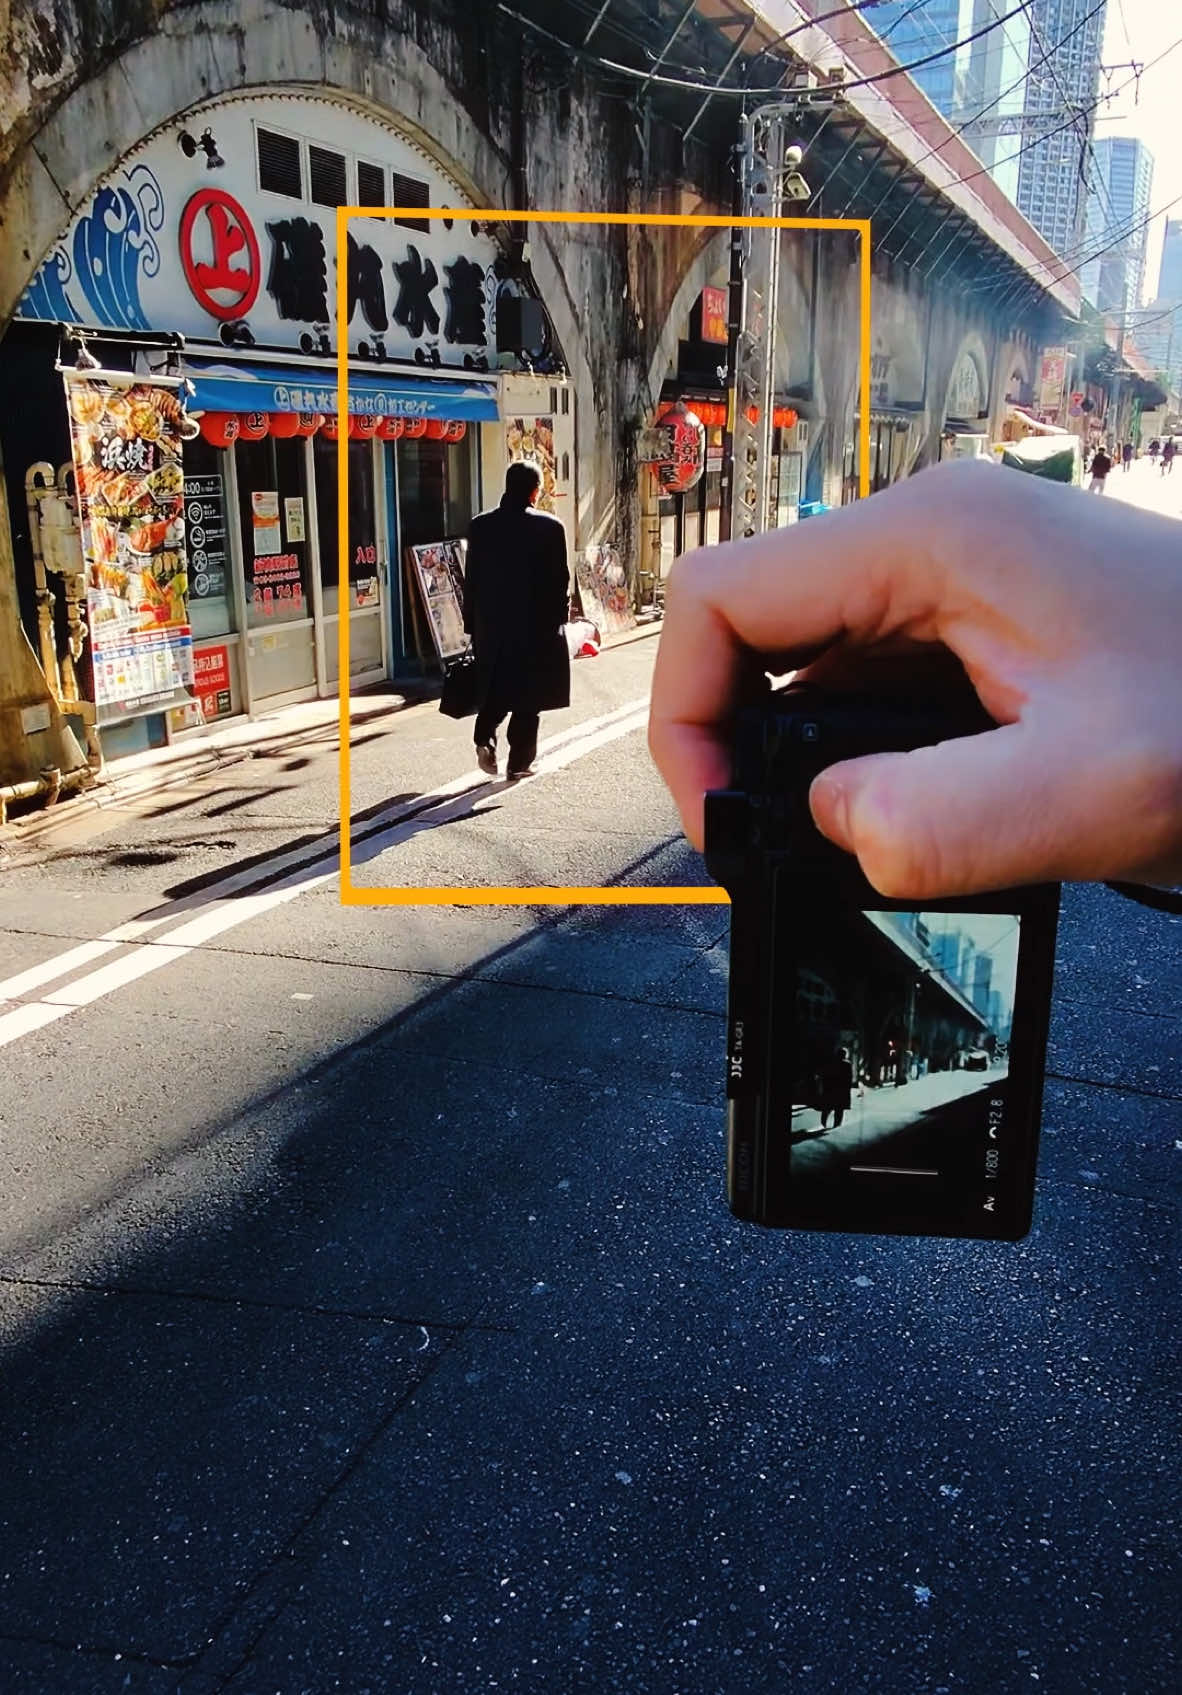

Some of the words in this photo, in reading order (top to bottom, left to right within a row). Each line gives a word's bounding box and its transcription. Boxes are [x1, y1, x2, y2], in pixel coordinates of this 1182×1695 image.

[100, 436, 148, 471] 浜焼
[730, 1056, 743, 1079] JJC
[985, 1149, 999, 1179] 1/800
[984, 1195, 996, 1212] Av
